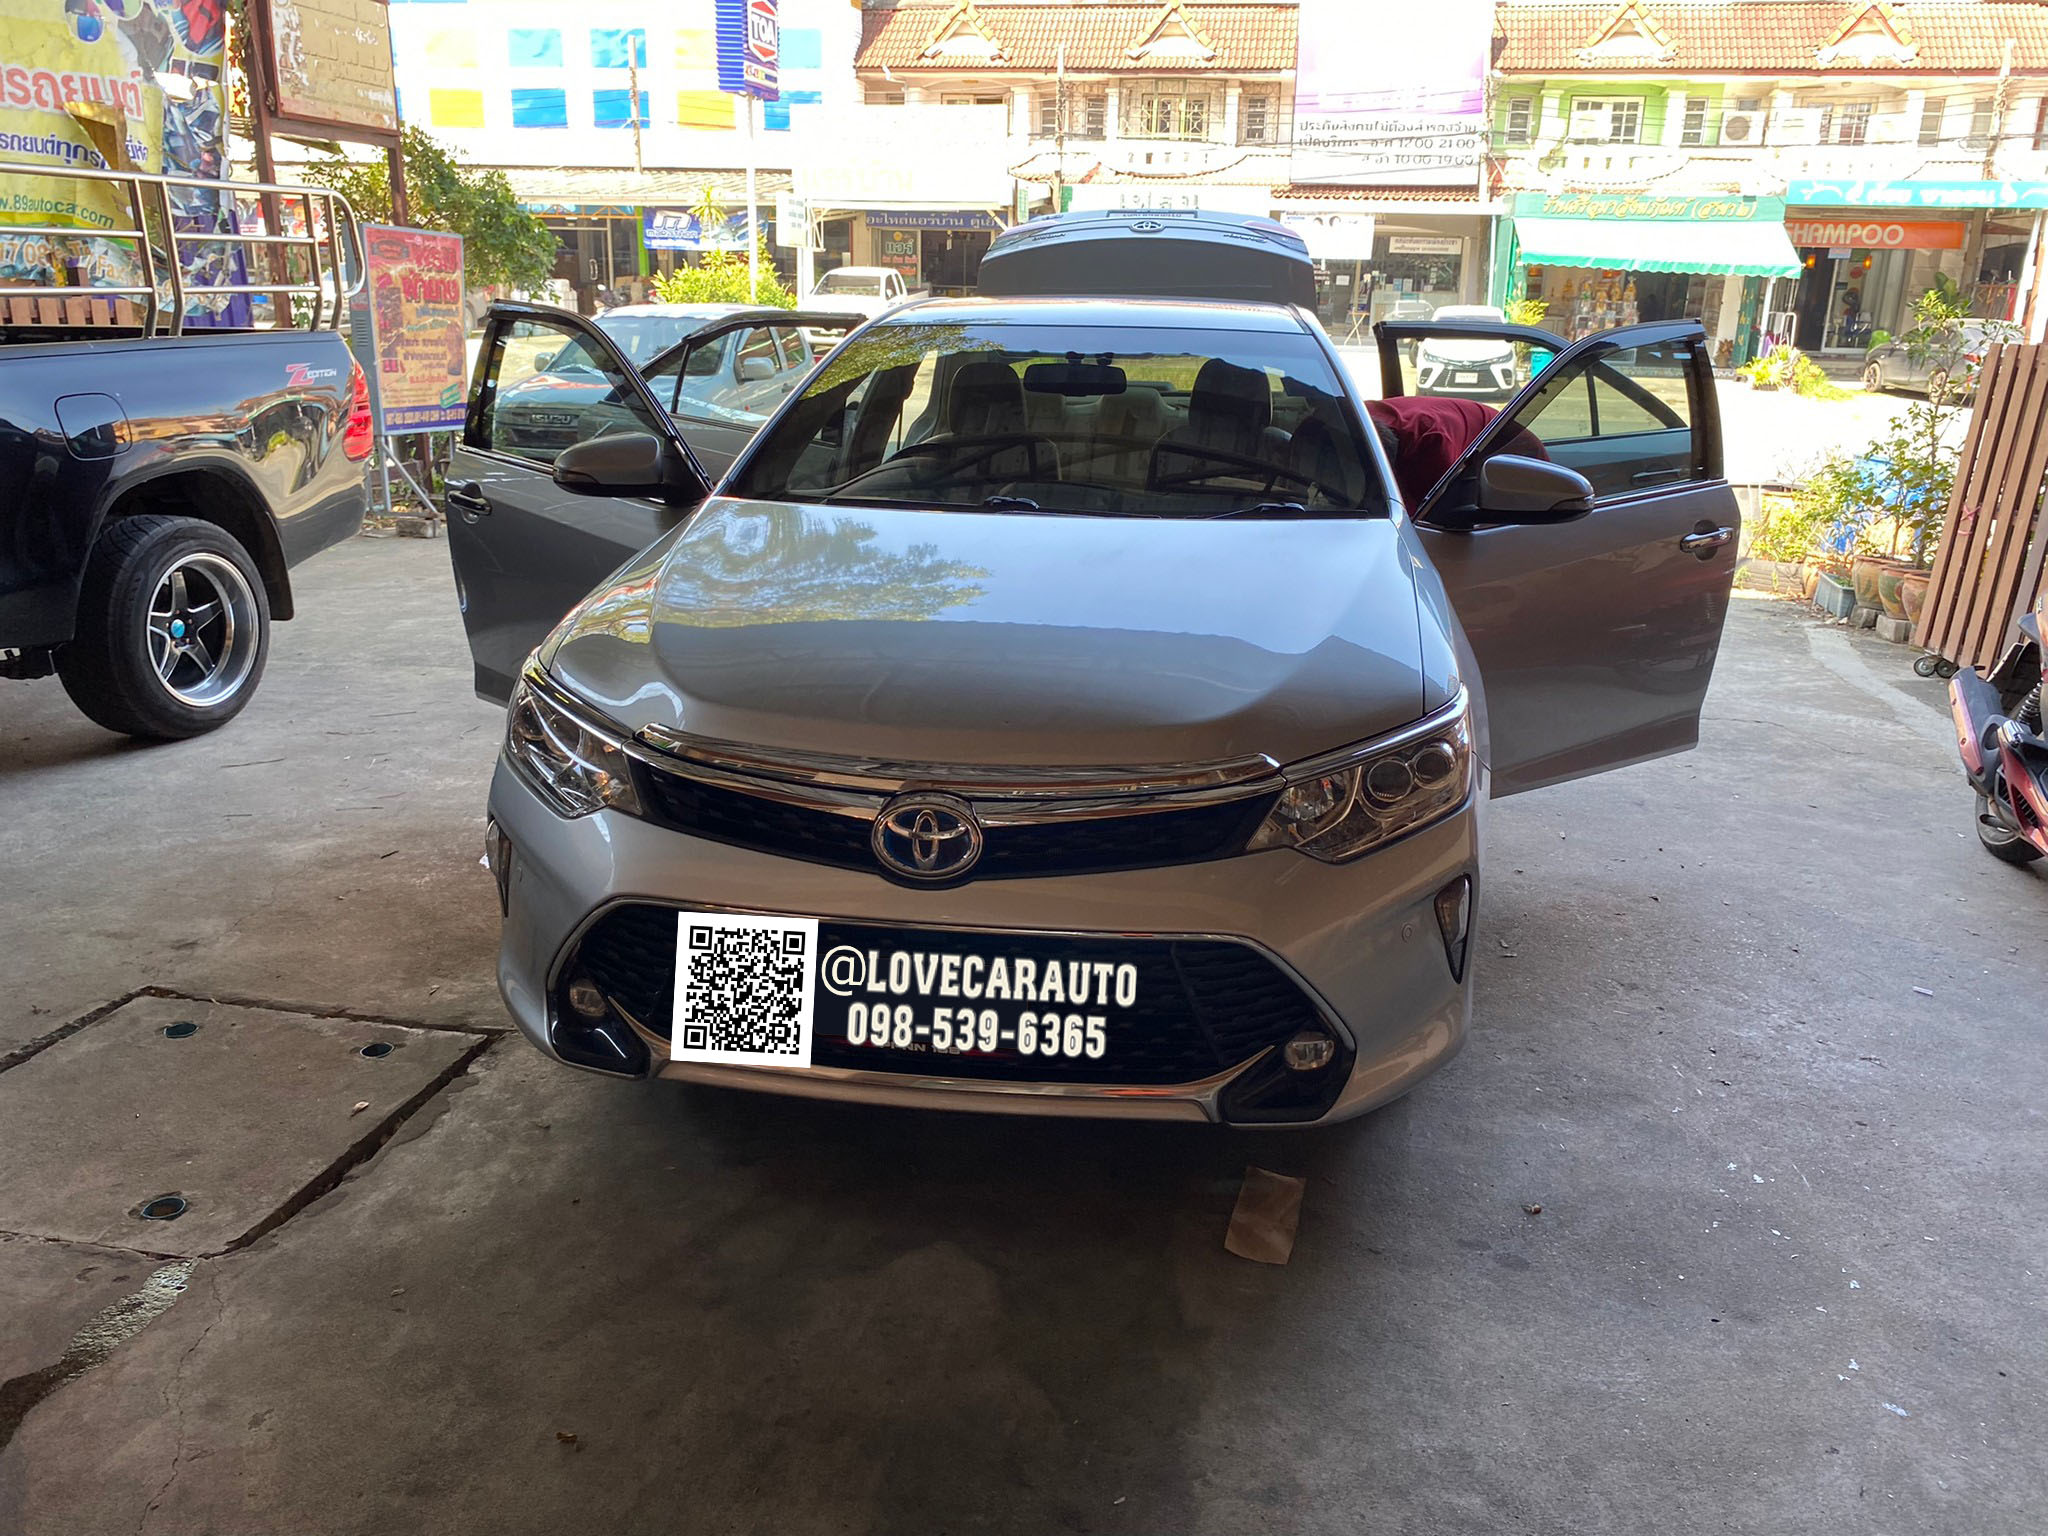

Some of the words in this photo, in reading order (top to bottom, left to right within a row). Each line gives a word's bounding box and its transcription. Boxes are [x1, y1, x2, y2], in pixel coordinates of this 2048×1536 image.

[751, 11, 777, 47] TOA
[970, 212, 998, 229] ตู้เย็
[531, 413, 572, 424] ISUZU
